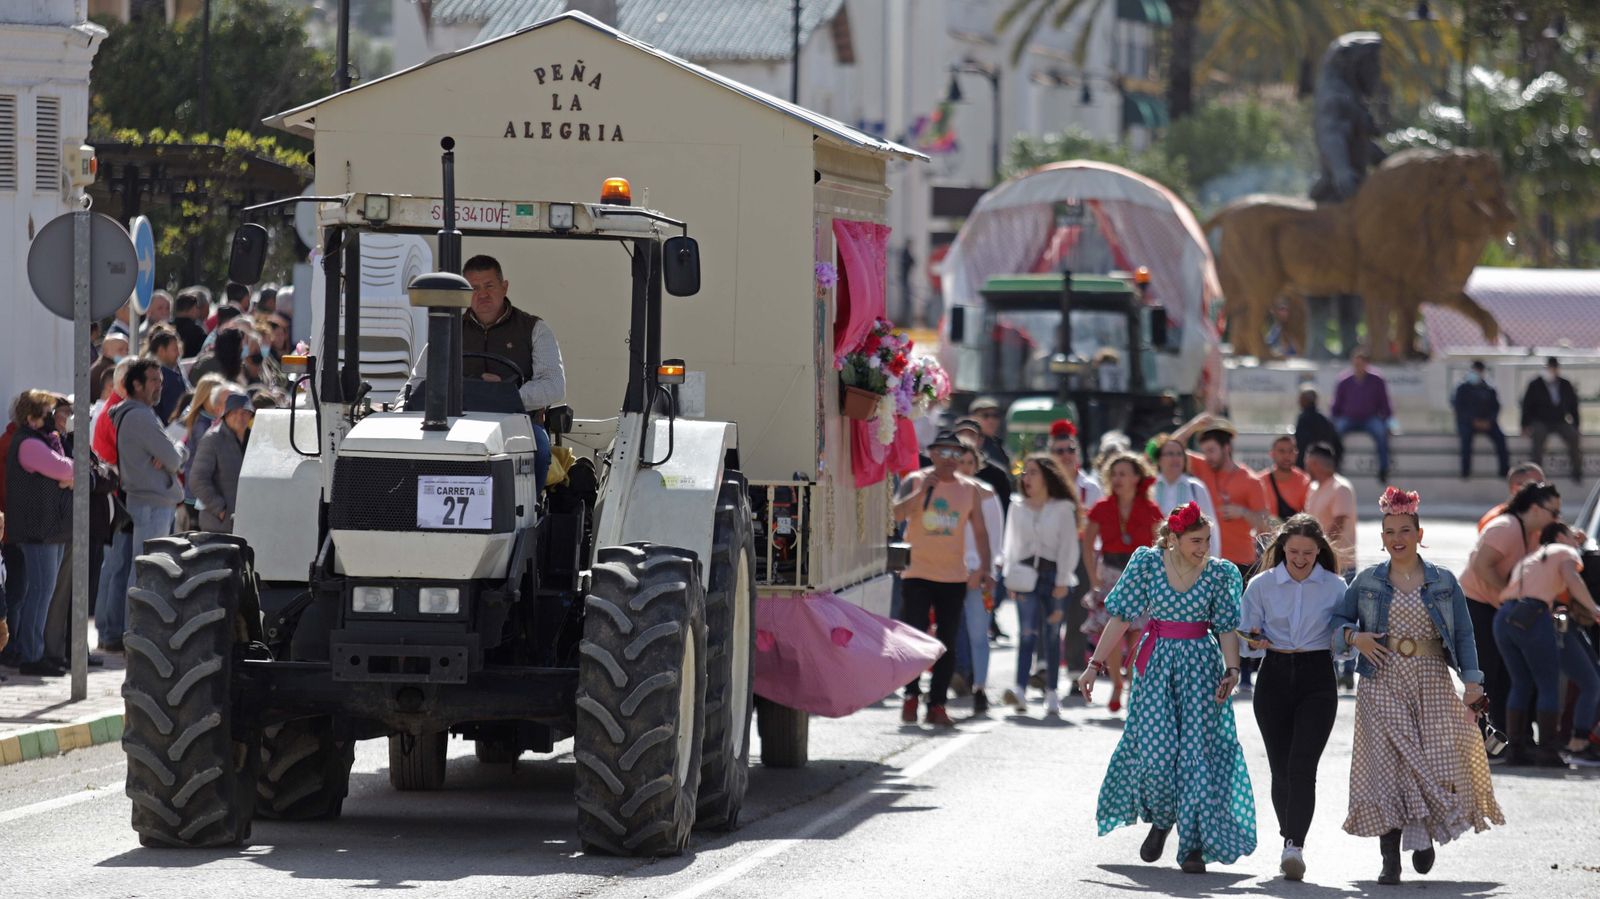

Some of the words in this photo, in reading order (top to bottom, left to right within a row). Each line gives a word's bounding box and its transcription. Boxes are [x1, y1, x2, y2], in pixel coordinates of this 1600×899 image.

[534, 59, 602, 90] PEÑA
[552, 93, 582, 111] LA
[504, 121, 624, 142] ALEGRIA
[432, 205, 509, 224] S53410VE
[437, 487, 475, 496] CARRETA
[442, 496, 469, 526] 27
